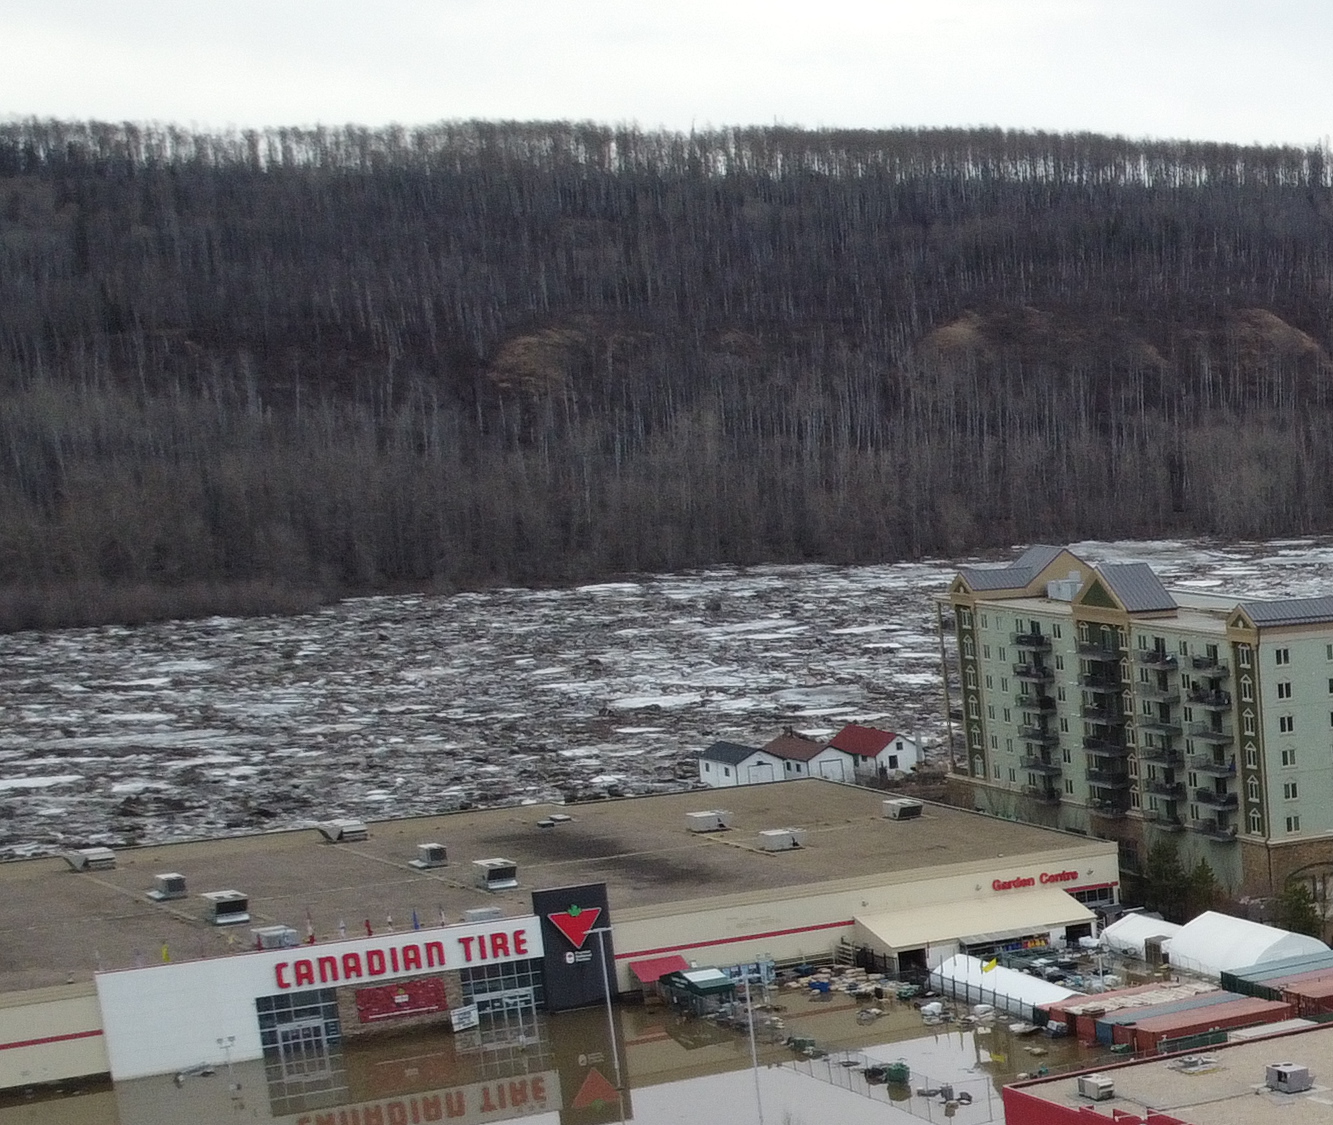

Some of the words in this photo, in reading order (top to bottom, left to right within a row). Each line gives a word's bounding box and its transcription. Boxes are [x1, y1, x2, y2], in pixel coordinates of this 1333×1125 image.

[992, 876, 1036, 891] Garden
[1039, 870, 1079, 885] Centre
[275, 941, 446, 989] CANADIAN
[458, 929, 529, 962] TIRE
